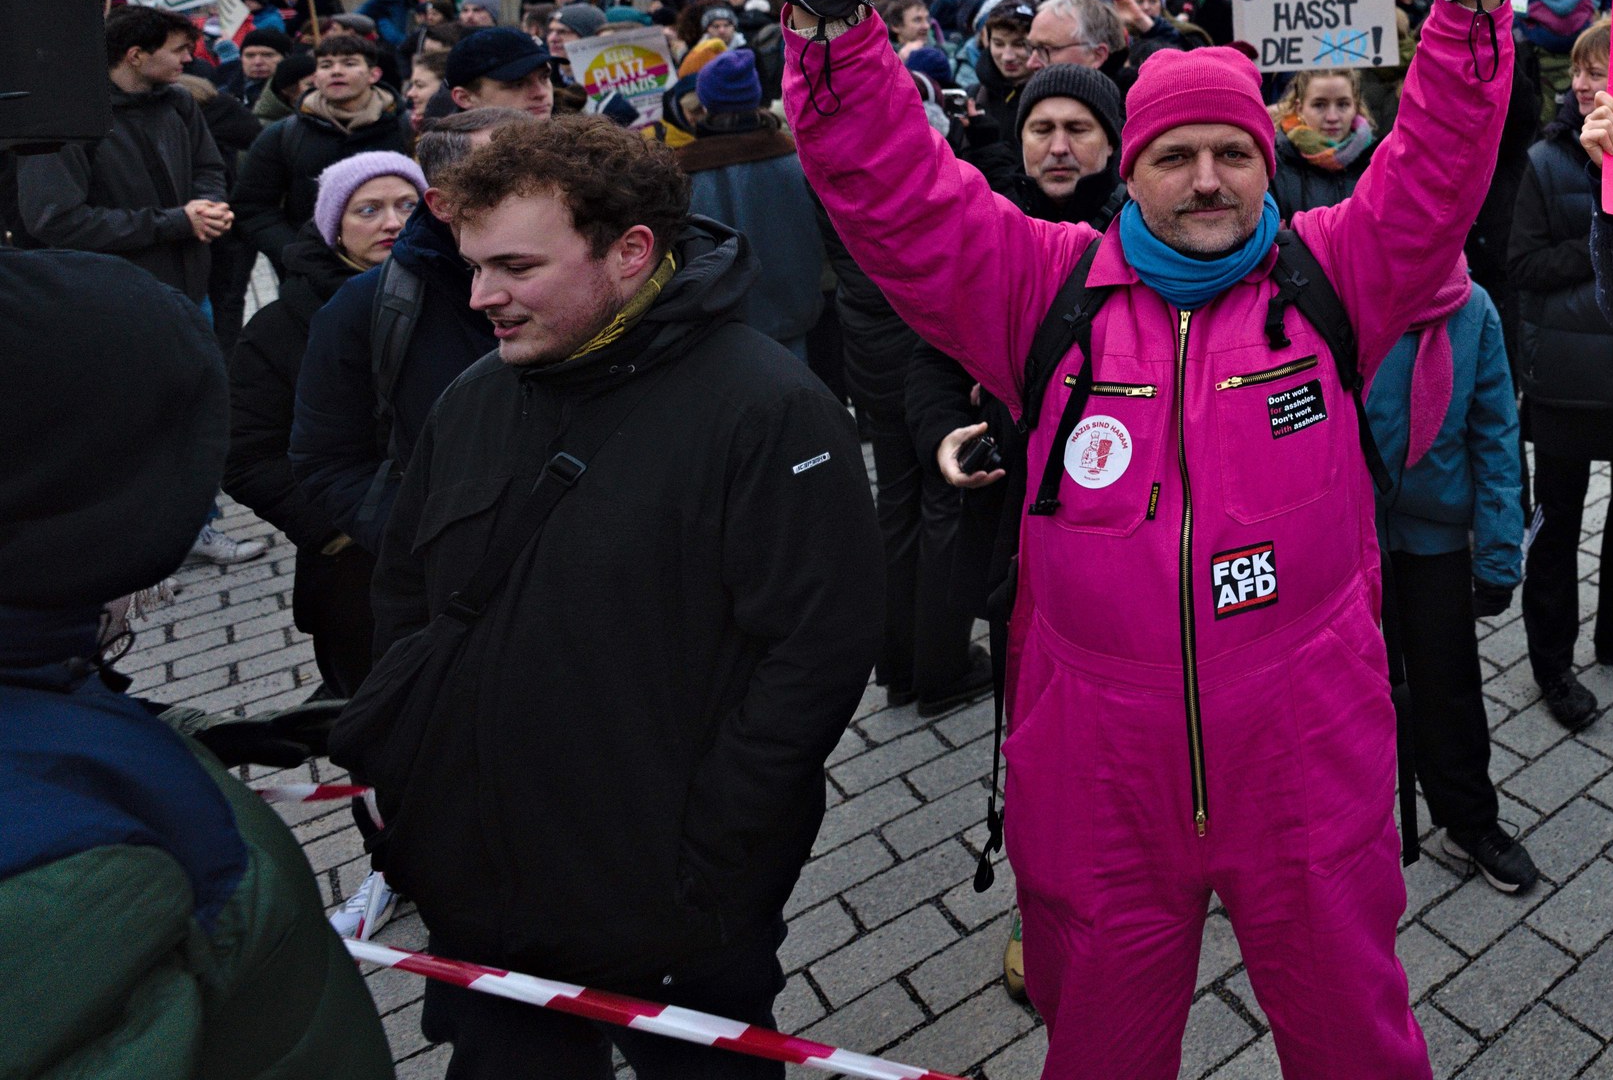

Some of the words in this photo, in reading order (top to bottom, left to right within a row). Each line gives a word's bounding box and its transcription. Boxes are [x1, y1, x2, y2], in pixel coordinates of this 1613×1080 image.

[1262, 38, 1303, 66] DIE
[593, 58, 648, 89] PLATZ
[1268, 392, 1291, 405] Don't
[1291, 385, 1309, 398] work
[1270, 407, 1283, 416] for
[1284, 394, 1317, 411] assholes.
[1272, 413, 1294, 426] Don't
[1295, 406, 1312, 418] work
[1273, 425, 1293, 436] with
[1293, 412, 1326, 430] assholes.
[1071, 423, 1091, 443] NAZIS
[1091, 421, 1110, 429] SIND
[1110, 425, 1129, 450] HARAM
[1213, 550, 1275, 587] FCK
[1217, 573, 1277, 609] AFD
